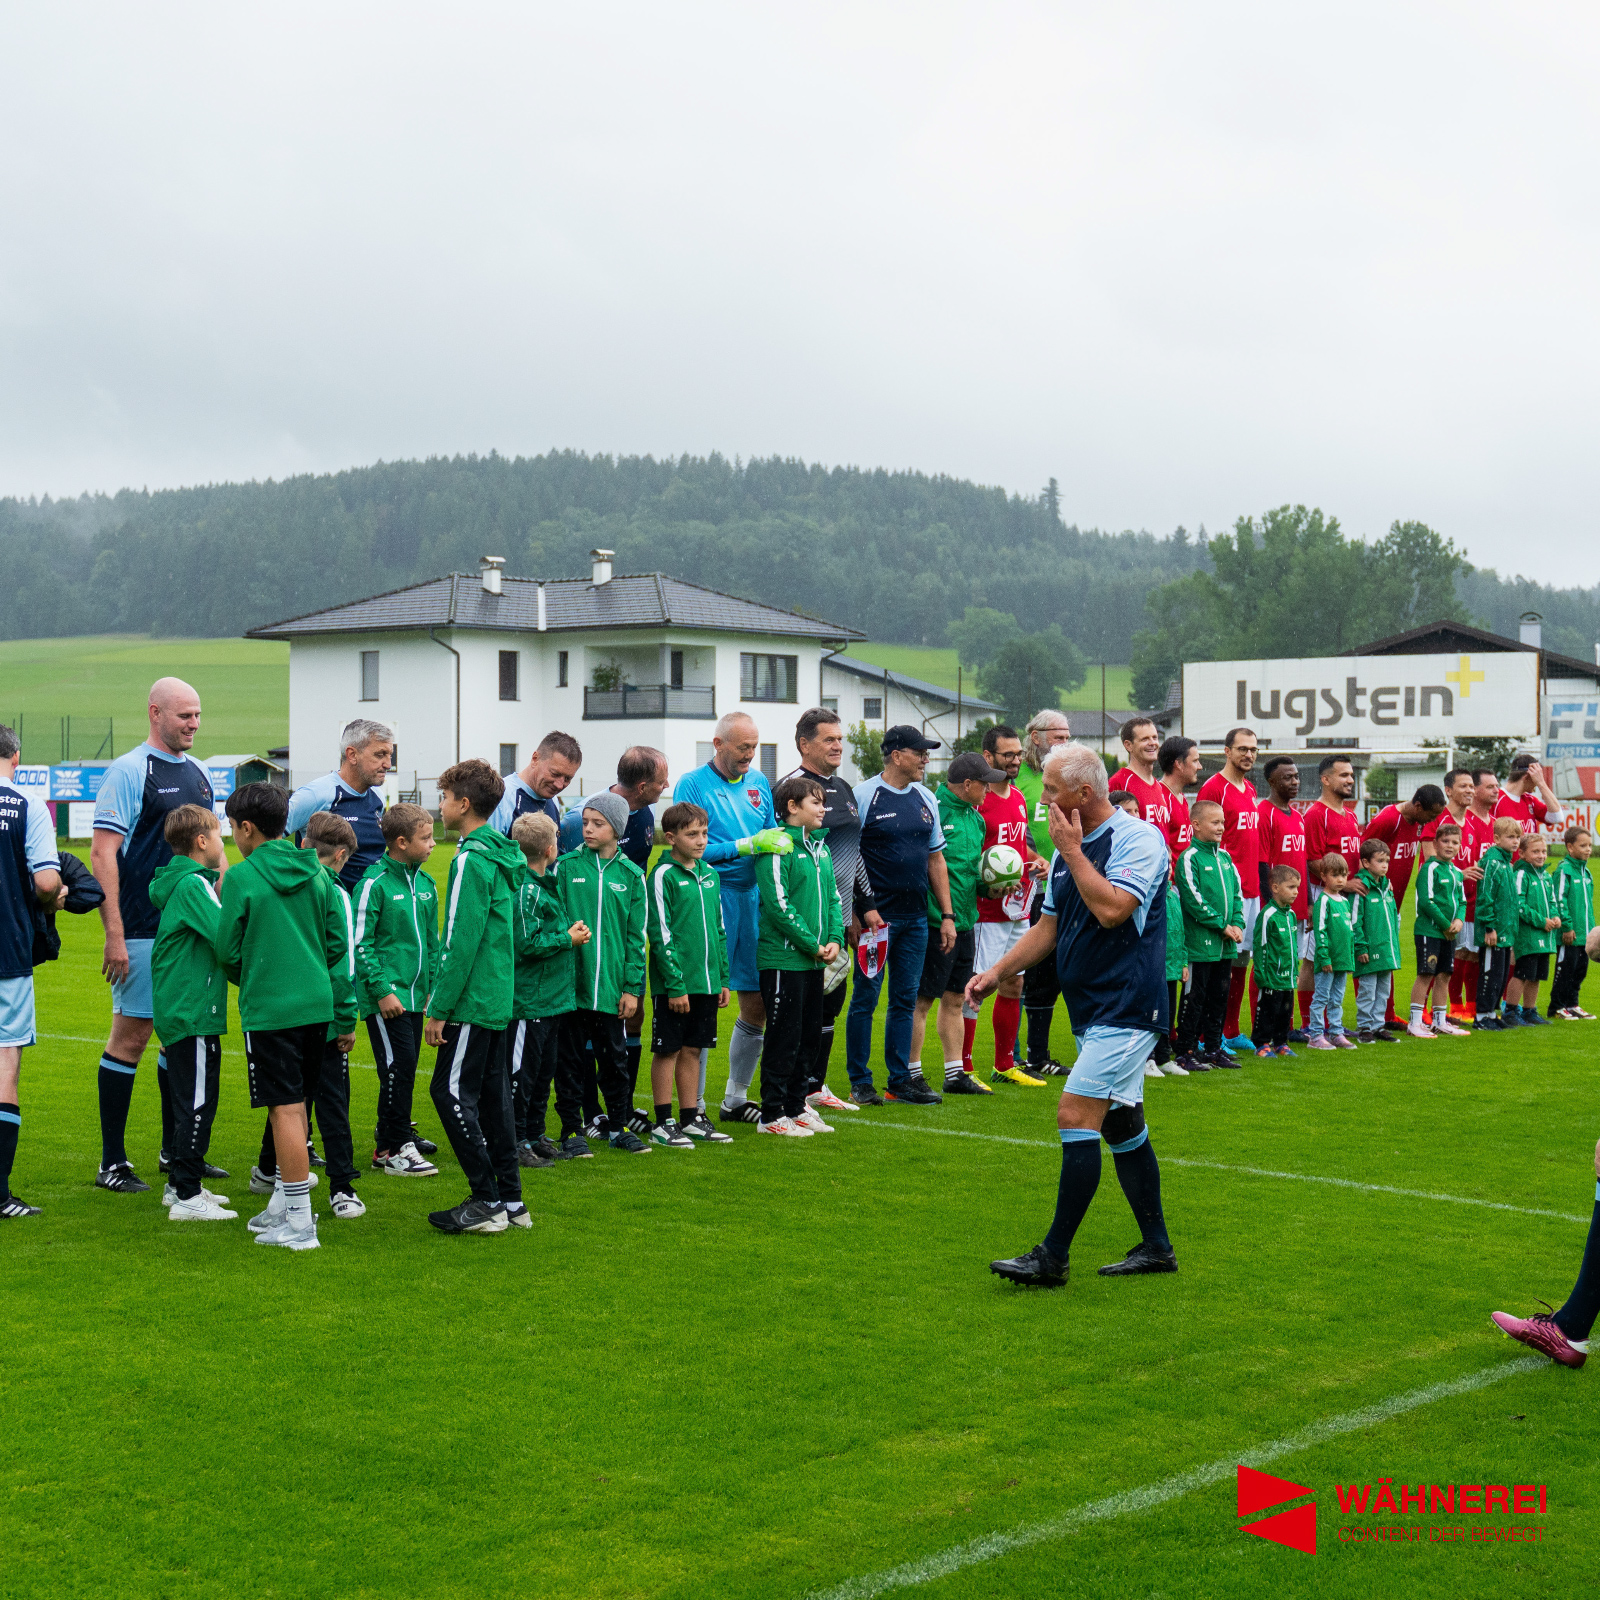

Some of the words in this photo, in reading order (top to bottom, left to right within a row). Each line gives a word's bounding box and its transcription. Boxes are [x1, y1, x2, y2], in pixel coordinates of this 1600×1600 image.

[1549, 746, 1595, 756] FENSTER
[876, 812, 897, 820] SHARP
[657, 1038, 663, 1046] 2
